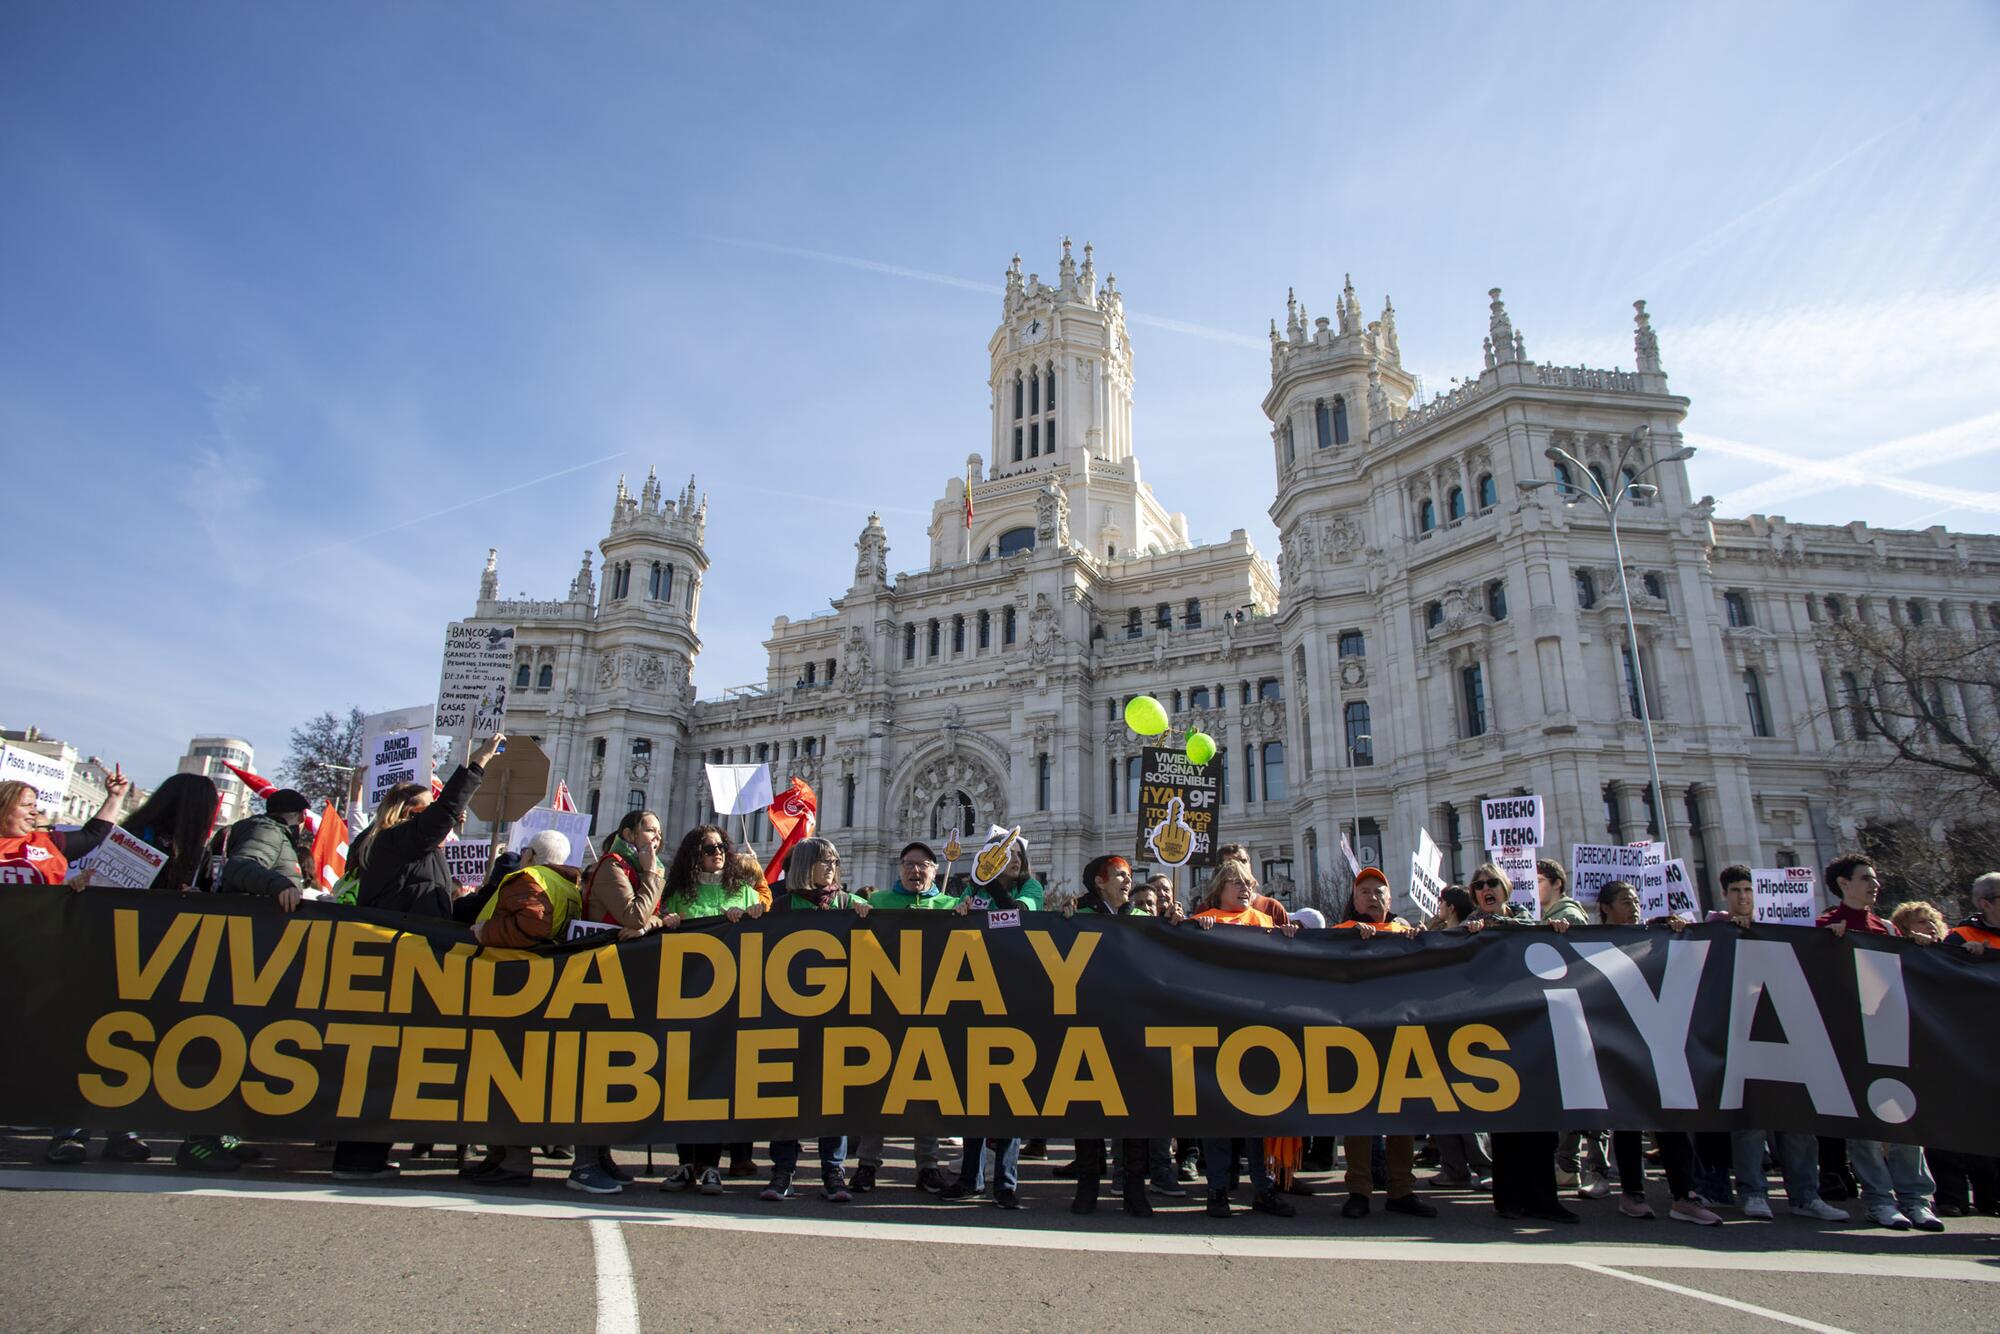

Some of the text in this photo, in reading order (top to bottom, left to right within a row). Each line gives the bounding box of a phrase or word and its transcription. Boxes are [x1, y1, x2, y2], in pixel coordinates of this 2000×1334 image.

[441, 703, 466, 711] CASAS
[436, 714, 465, 728] BASTA
[383, 736, 410, 752] BANCO
[375, 747, 418, 766] SANTANDER
[36, 763, 65, 780] prisiones
[377, 769, 415, 787] CERBERUS
[1158, 763, 1206, 776] DIGNA Y
[1145, 772, 1217, 788] SOSTENIBLE
[1189, 789, 1216, 808] 9F
[1486, 799, 1535, 820] DERECHO
[1491, 826, 1538, 847] A TECHO.
[445, 844, 491, 860] ERECHO
[1612, 848, 1618, 865] A
[1414, 861, 1440, 898] SIN CASA
[1576, 872, 1582, 889] A
[1788, 868, 1812, 877] NO+
[1412, 879, 1416, 895] A
[1415, 884, 1422, 902] LA
[1757, 878, 1809, 897] ¡Hipotecas
[991, 912, 1017, 922] NO+
[1759, 902, 1811, 921] y alquileres
[113, 909, 1100, 1020] VIVIENDA DIGNA Y
[1525, 938, 1917, 1124] ¡YA!
[78, 1010, 1521, 1124] SOSTENIBLE PARA TODAS
